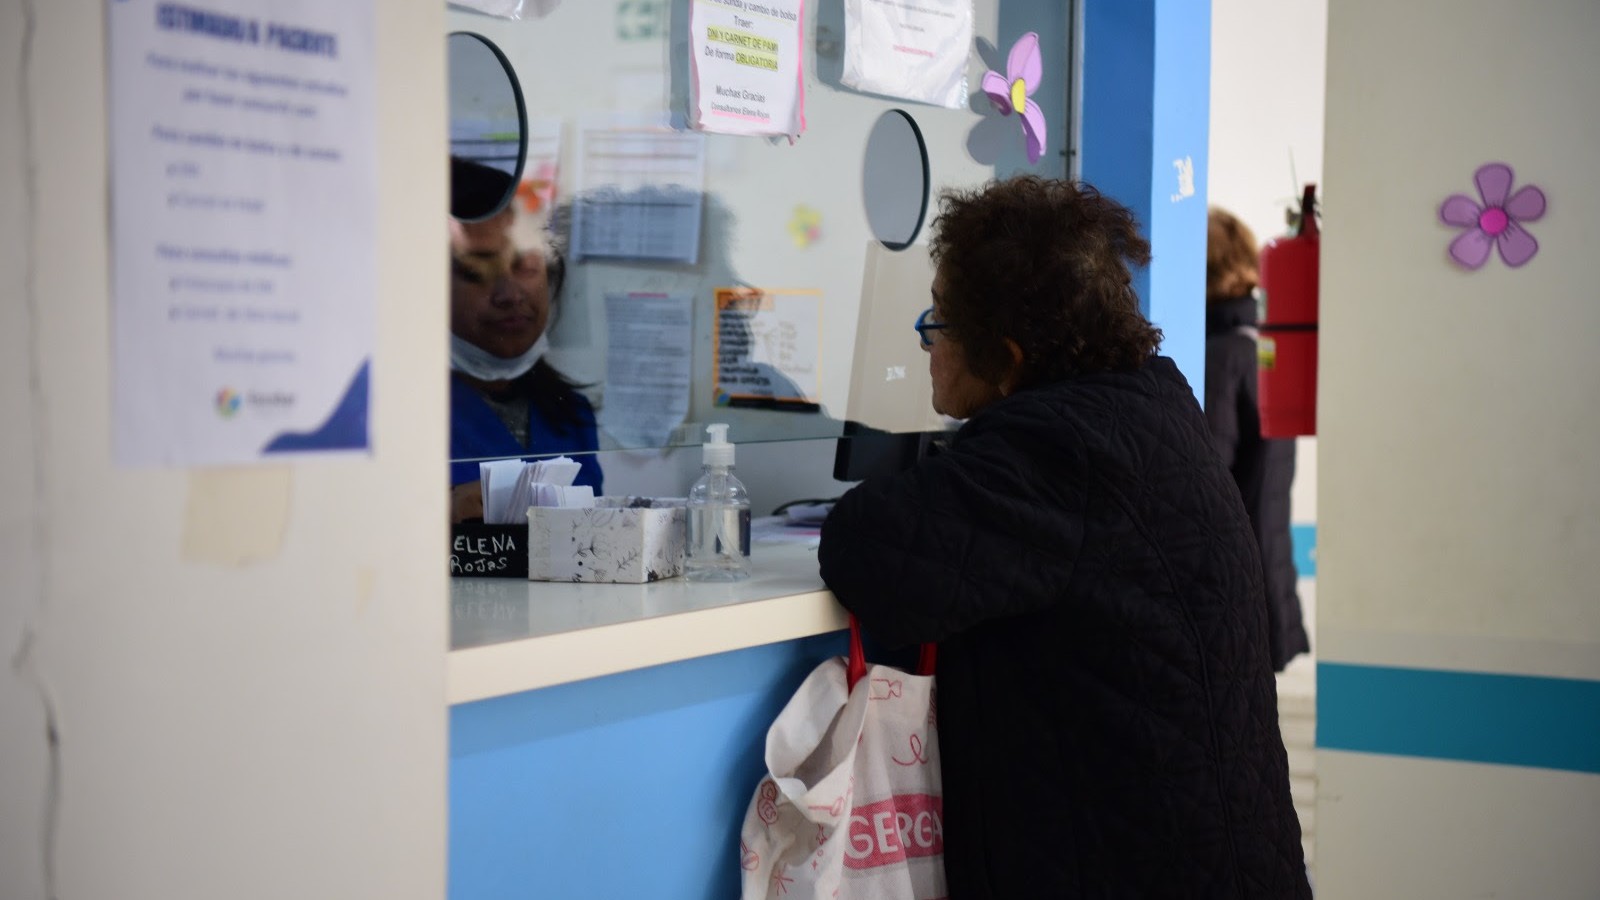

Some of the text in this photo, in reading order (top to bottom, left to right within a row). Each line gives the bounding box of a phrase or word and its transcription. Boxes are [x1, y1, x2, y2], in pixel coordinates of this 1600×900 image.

[748, 3, 769, 15] cambio
[771, 7, 779, 17] de
[780, 8, 797, 21] bolsa
[725, 32, 751, 47] CARNET
[753, 38, 761, 48] DE
[705, 45, 778, 69] De forma OBLIGATORIA
[716, 85, 766, 103] Muchas Gracias
[453, 533, 516, 555] ELENA
